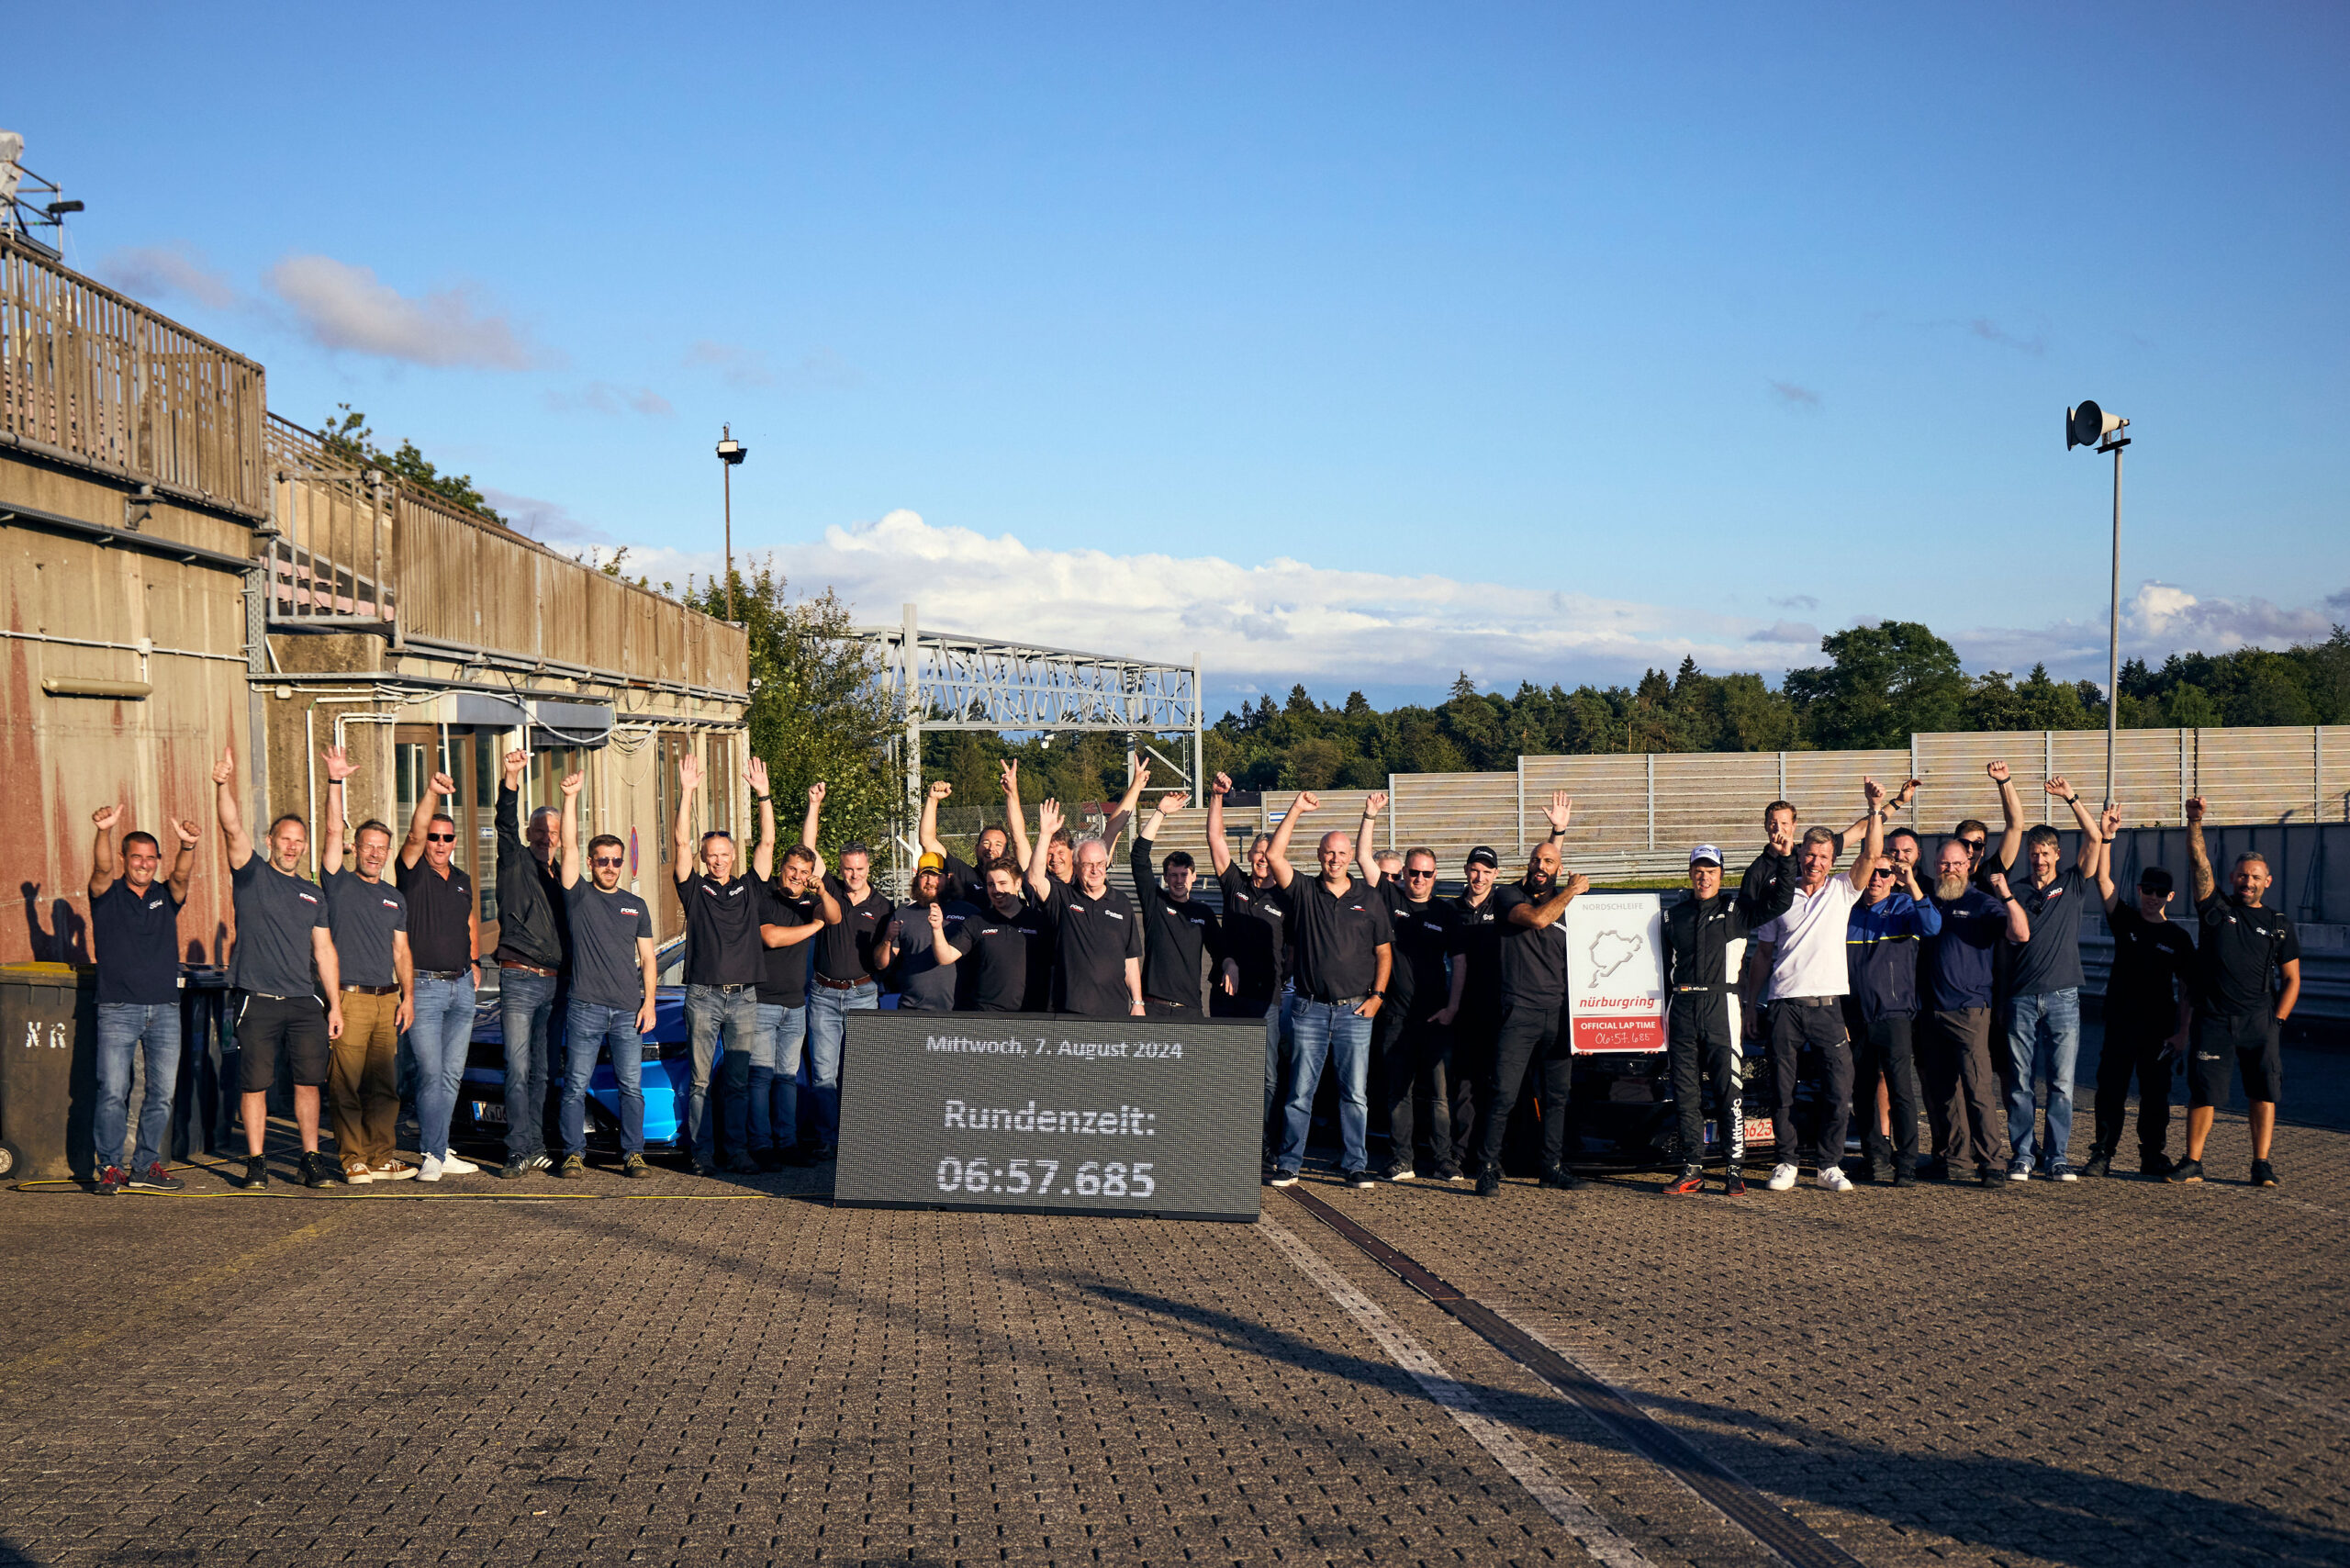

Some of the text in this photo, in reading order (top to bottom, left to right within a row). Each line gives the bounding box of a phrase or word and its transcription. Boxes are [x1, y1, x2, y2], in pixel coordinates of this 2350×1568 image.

[1582, 902, 1644, 911] NORDSCHLEIFE
[1579, 996, 1655, 1010] nürburgring
[1580, 1021, 1656, 1030] OFFICIAL LAP TIME
[925, 1035, 1183, 1060] Mittwoch, 7. August 2024
[944, 1100, 1156, 1137] Rundenzeit:
[936, 1156, 1157, 1198] 06:57.685
